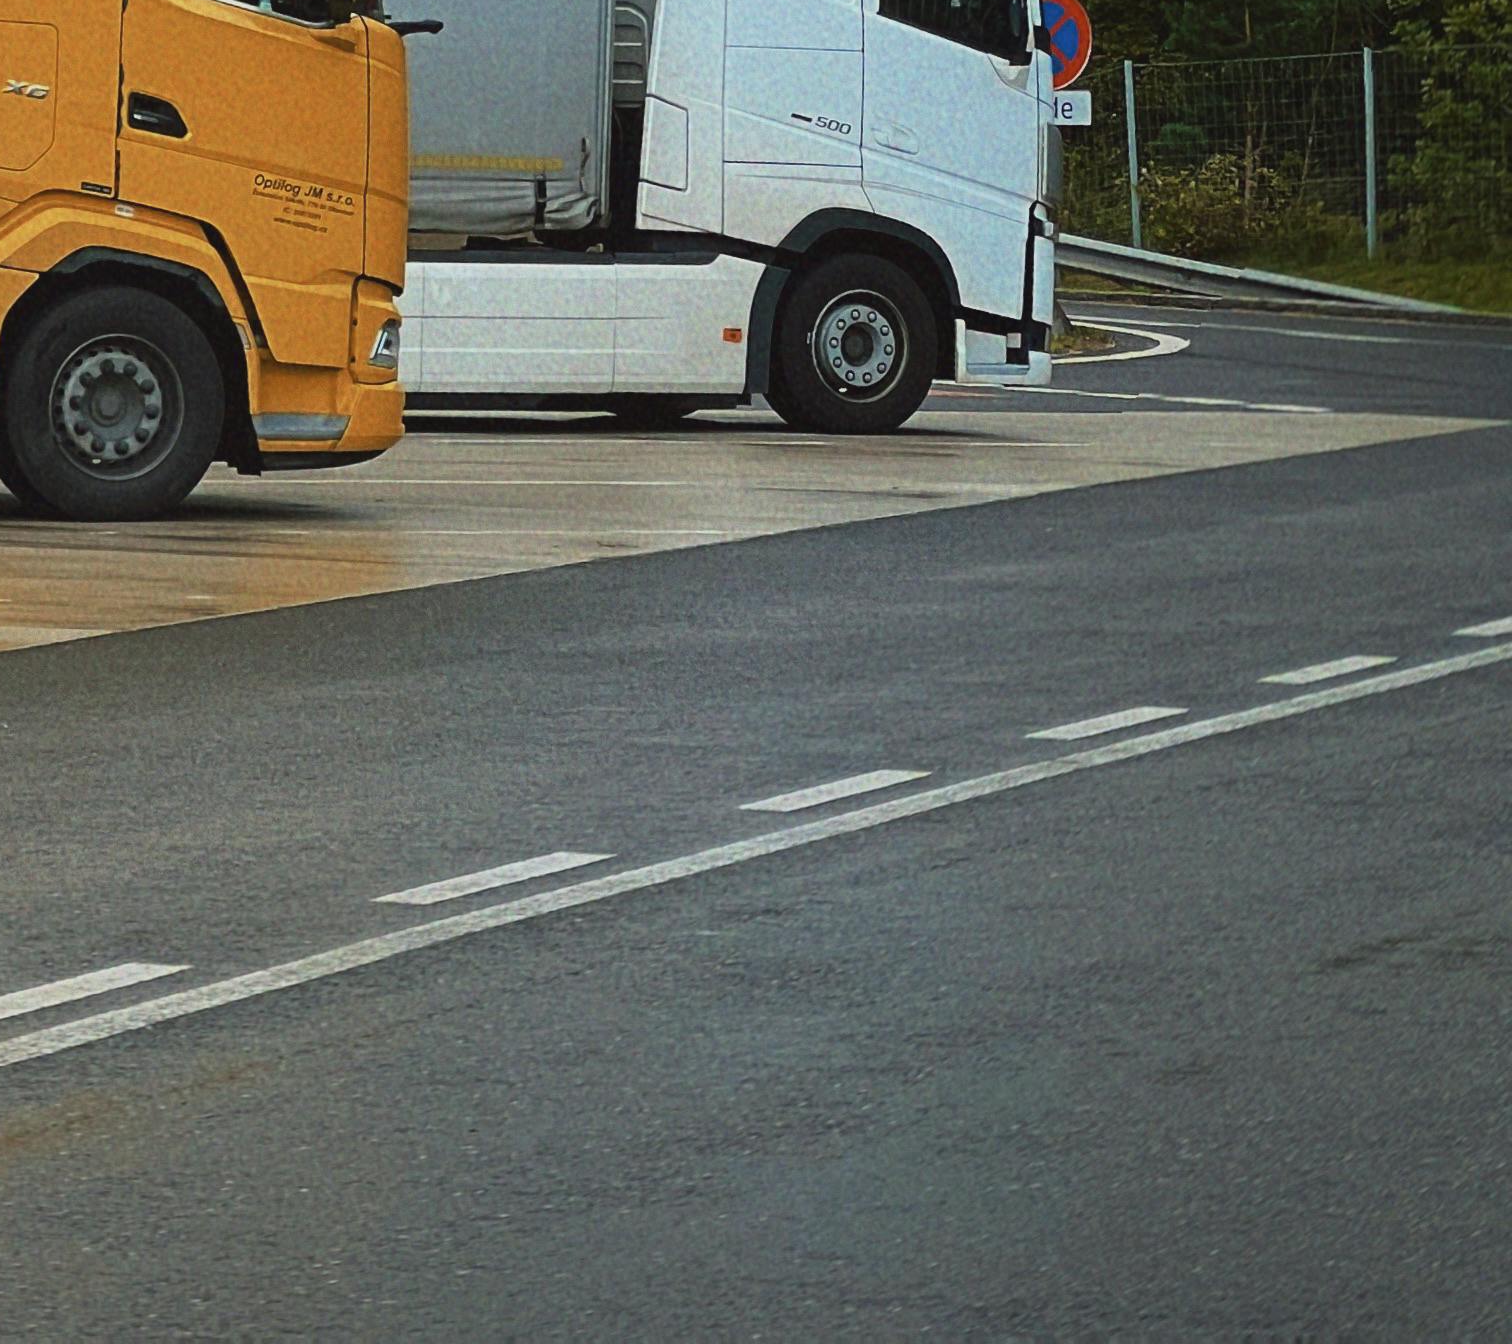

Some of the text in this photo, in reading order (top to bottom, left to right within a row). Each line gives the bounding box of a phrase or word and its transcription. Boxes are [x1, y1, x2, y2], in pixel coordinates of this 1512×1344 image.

[815, 116, 852, 135] 500
[254, 174, 301, 196] Optilog
[304, 186, 323, 199] JM
